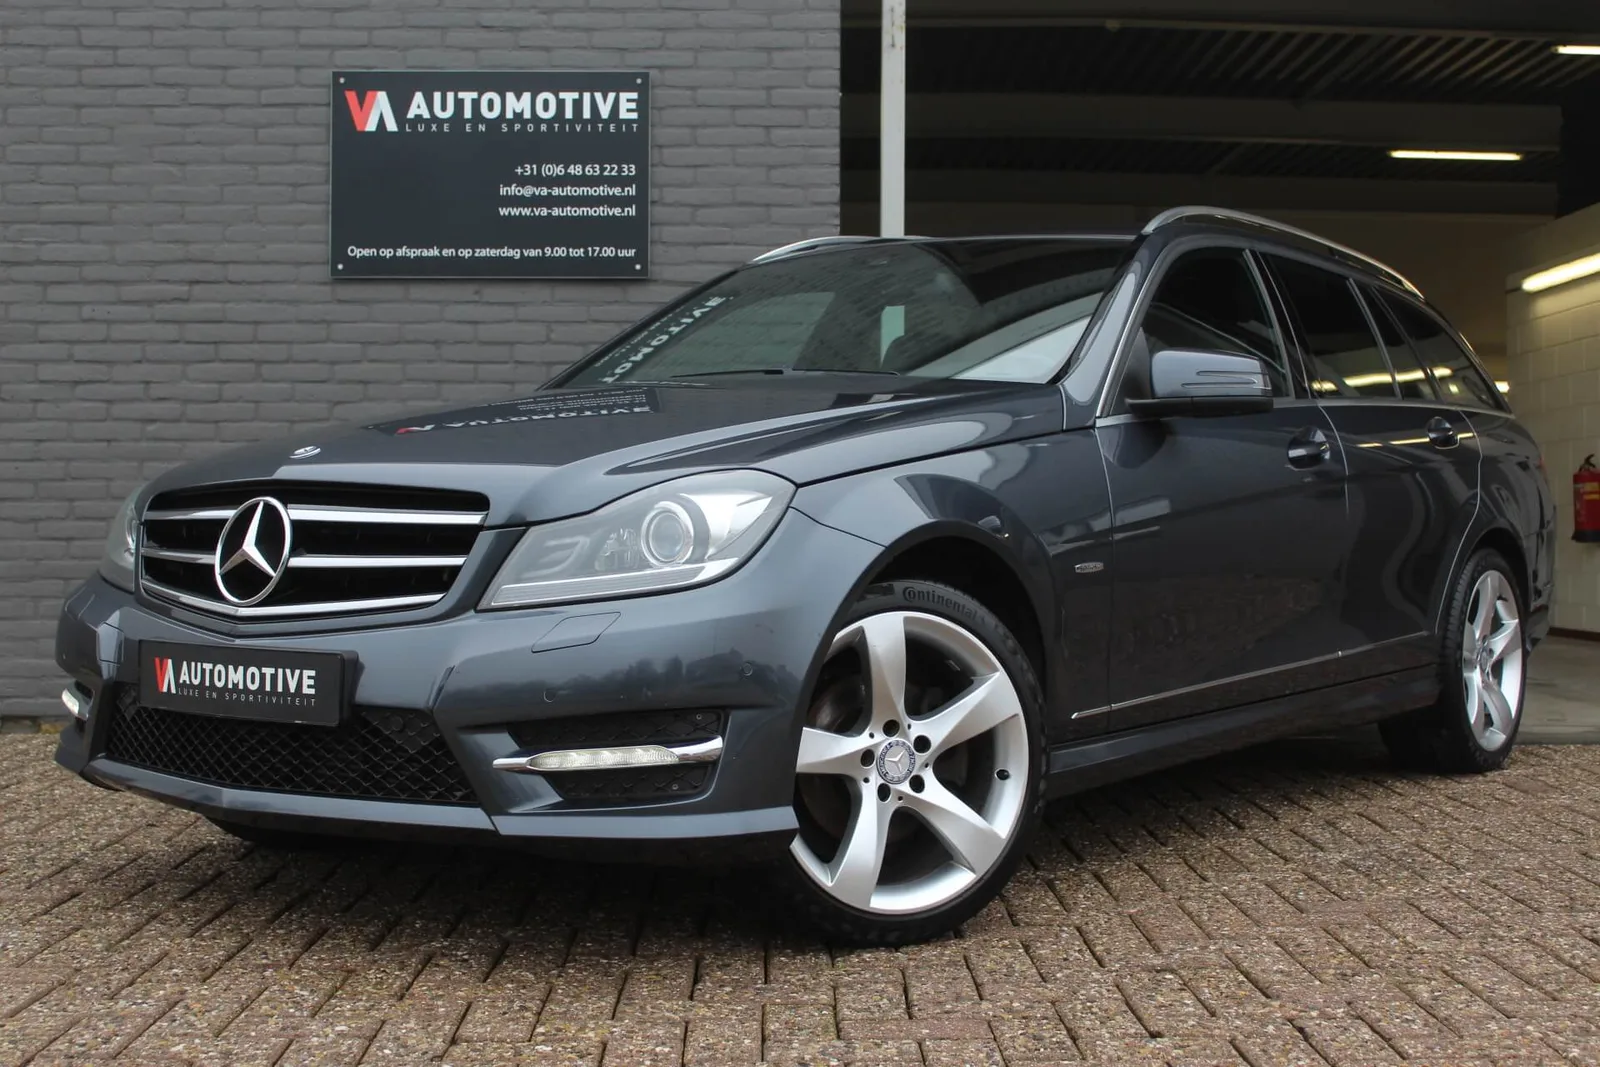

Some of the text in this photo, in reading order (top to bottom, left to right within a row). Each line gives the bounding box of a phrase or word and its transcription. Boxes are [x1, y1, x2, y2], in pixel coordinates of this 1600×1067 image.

[344, 90, 639, 132] VA AUTOMOTIVE
[405, 123, 639, 132] LUXE EN SPORTIVITEIT
[514, 163, 636, 177] +31 (0)6 48 63 22 33
[499, 183, 637, 197] info@va-automotive.nl
[498, 204, 637, 217] www.va-automotive.nl
[347, 245, 636, 259] Open op afspraak en op zaterdag van 9.00 tot 17.00 uur
[902, 586, 978, 621] Continental
[179, 660, 316, 695] AUTOMOTIVE
[178, 687, 316, 706] LUXE EN SPORTIVITEIT
